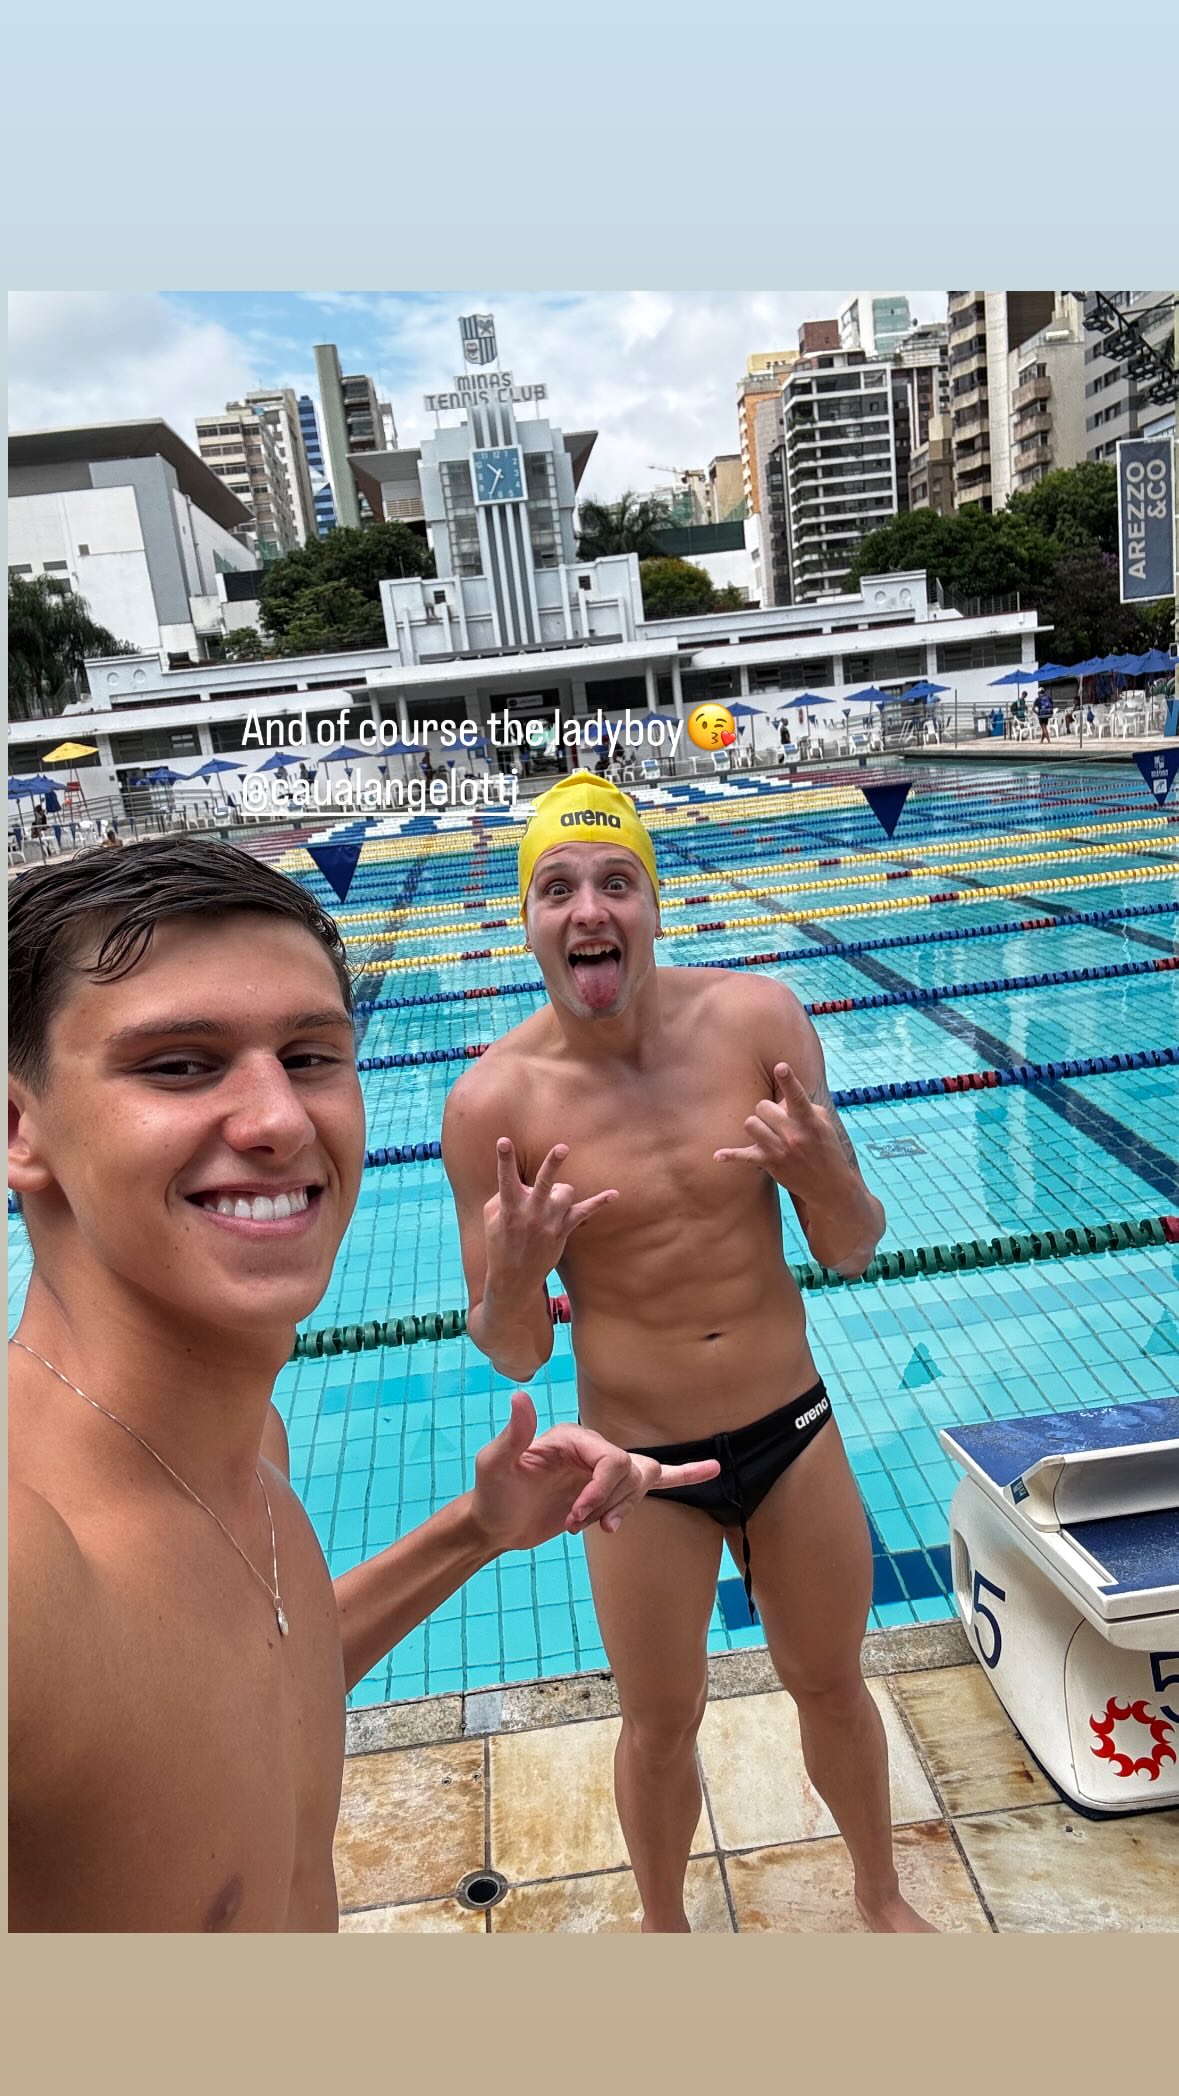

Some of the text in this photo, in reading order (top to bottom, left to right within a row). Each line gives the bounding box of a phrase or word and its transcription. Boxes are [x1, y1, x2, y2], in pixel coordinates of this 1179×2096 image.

[425, 384, 546, 409] TENNIS CLUB
[457, 373, 512, 391] MINAS
[1147, 458, 1167, 519] &CO
[1126, 461, 1146, 580] AREZZO
[560, 809, 621, 829] arena
[794, 1396, 829, 1430] arena
[973, 1570, 1006, 1669] 5
[1149, 1651, 1179, 1724] 5
